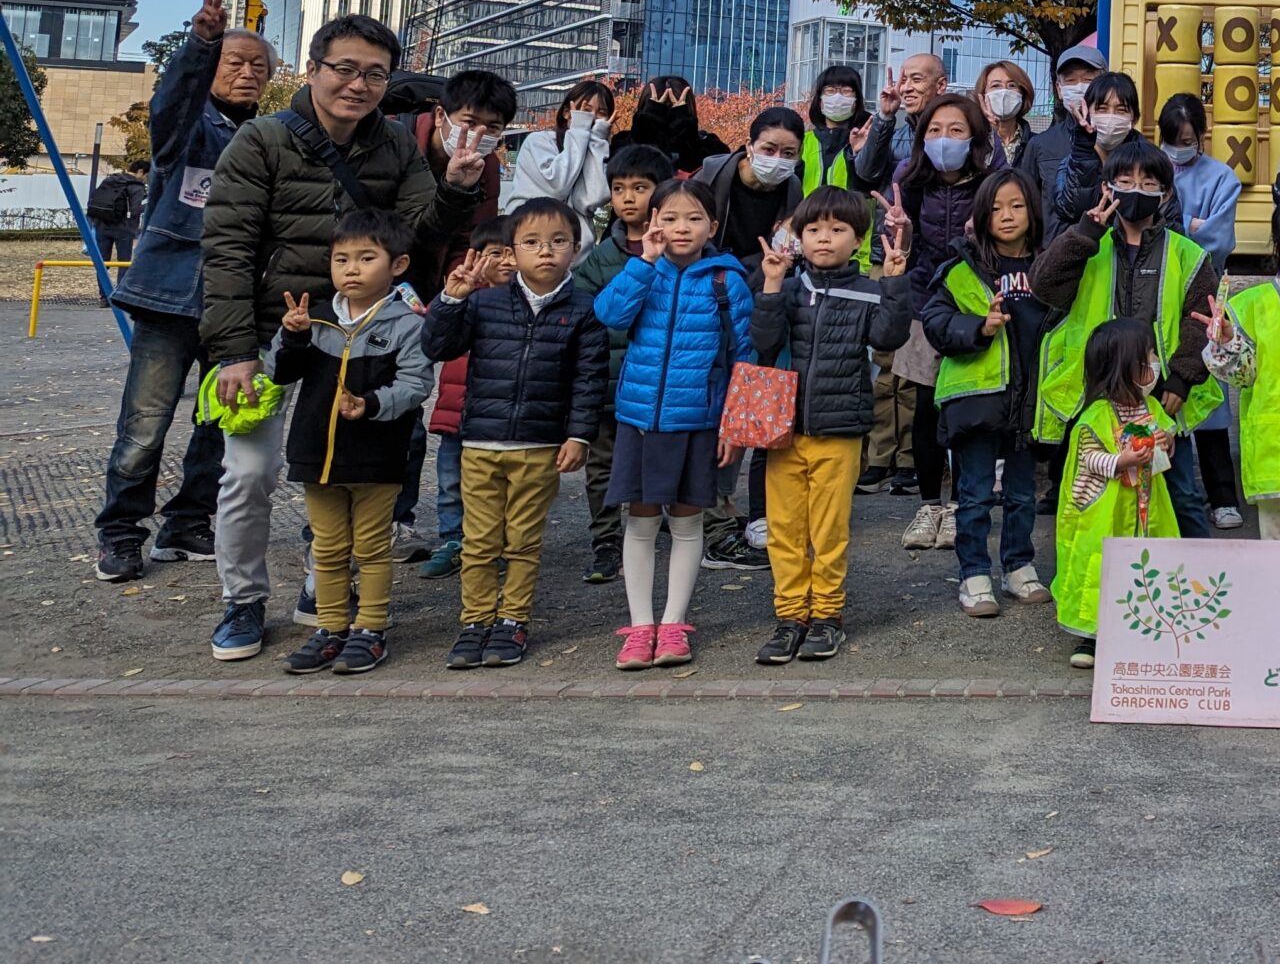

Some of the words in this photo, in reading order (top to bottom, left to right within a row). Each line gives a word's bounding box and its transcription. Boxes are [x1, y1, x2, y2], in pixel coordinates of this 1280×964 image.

[994, 272, 1032, 294] OMM
[1113, 661, 1232, 679] 高島中央公園愛護会
[1111, 683, 1166, 696] Takashima
[1169, 685, 1205, 697] Central
[1208, 687, 1231, 698] Park
[1111, 697, 1189, 709] GARDENING
[1198, 699, 1231, 711] CLUB
